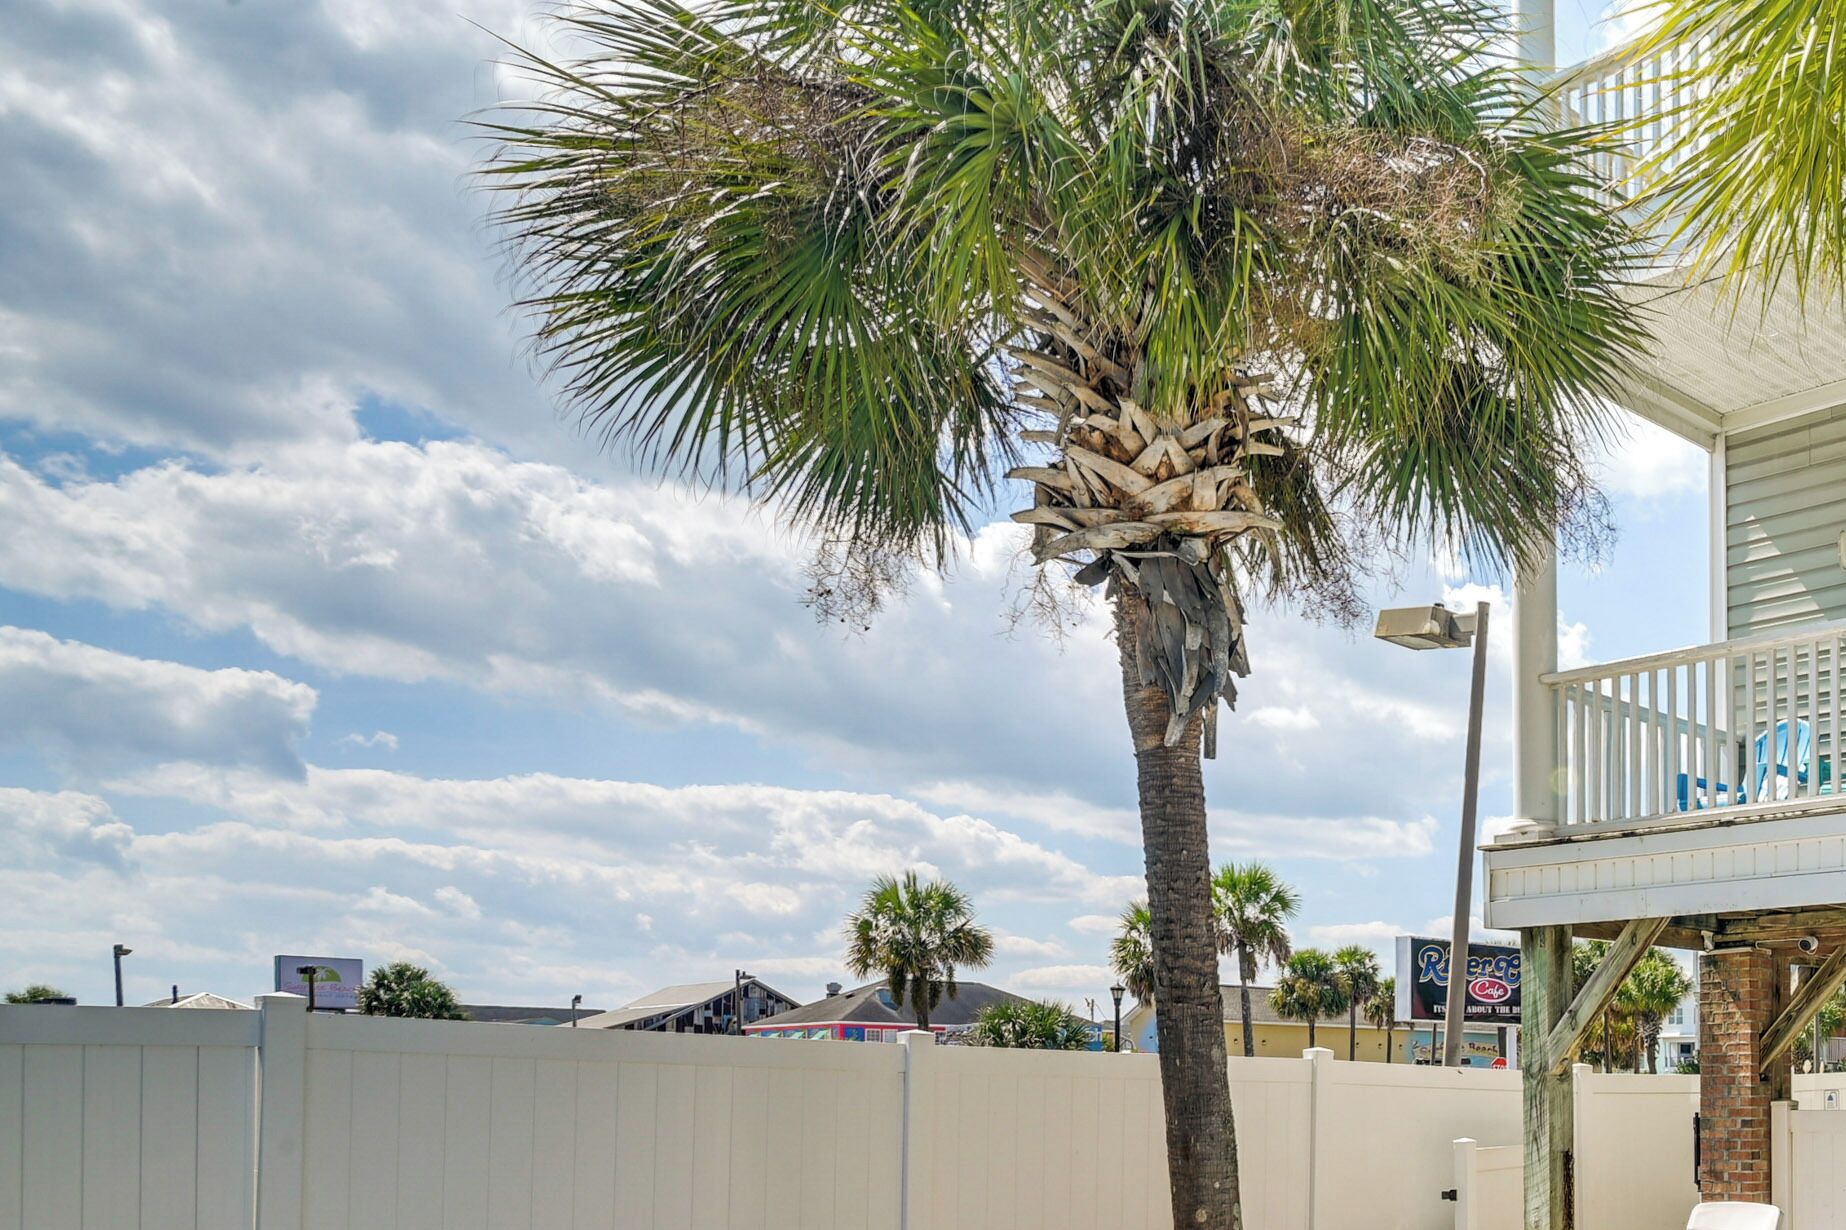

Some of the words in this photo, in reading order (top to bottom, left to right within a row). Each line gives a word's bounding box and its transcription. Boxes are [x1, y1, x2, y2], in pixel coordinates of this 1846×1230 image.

[1476, 980, 1505, 998] Cafe
[1466, 1005, 1492, 1014] ABOUT
[1494, 1005, 1511, 1014] THE
